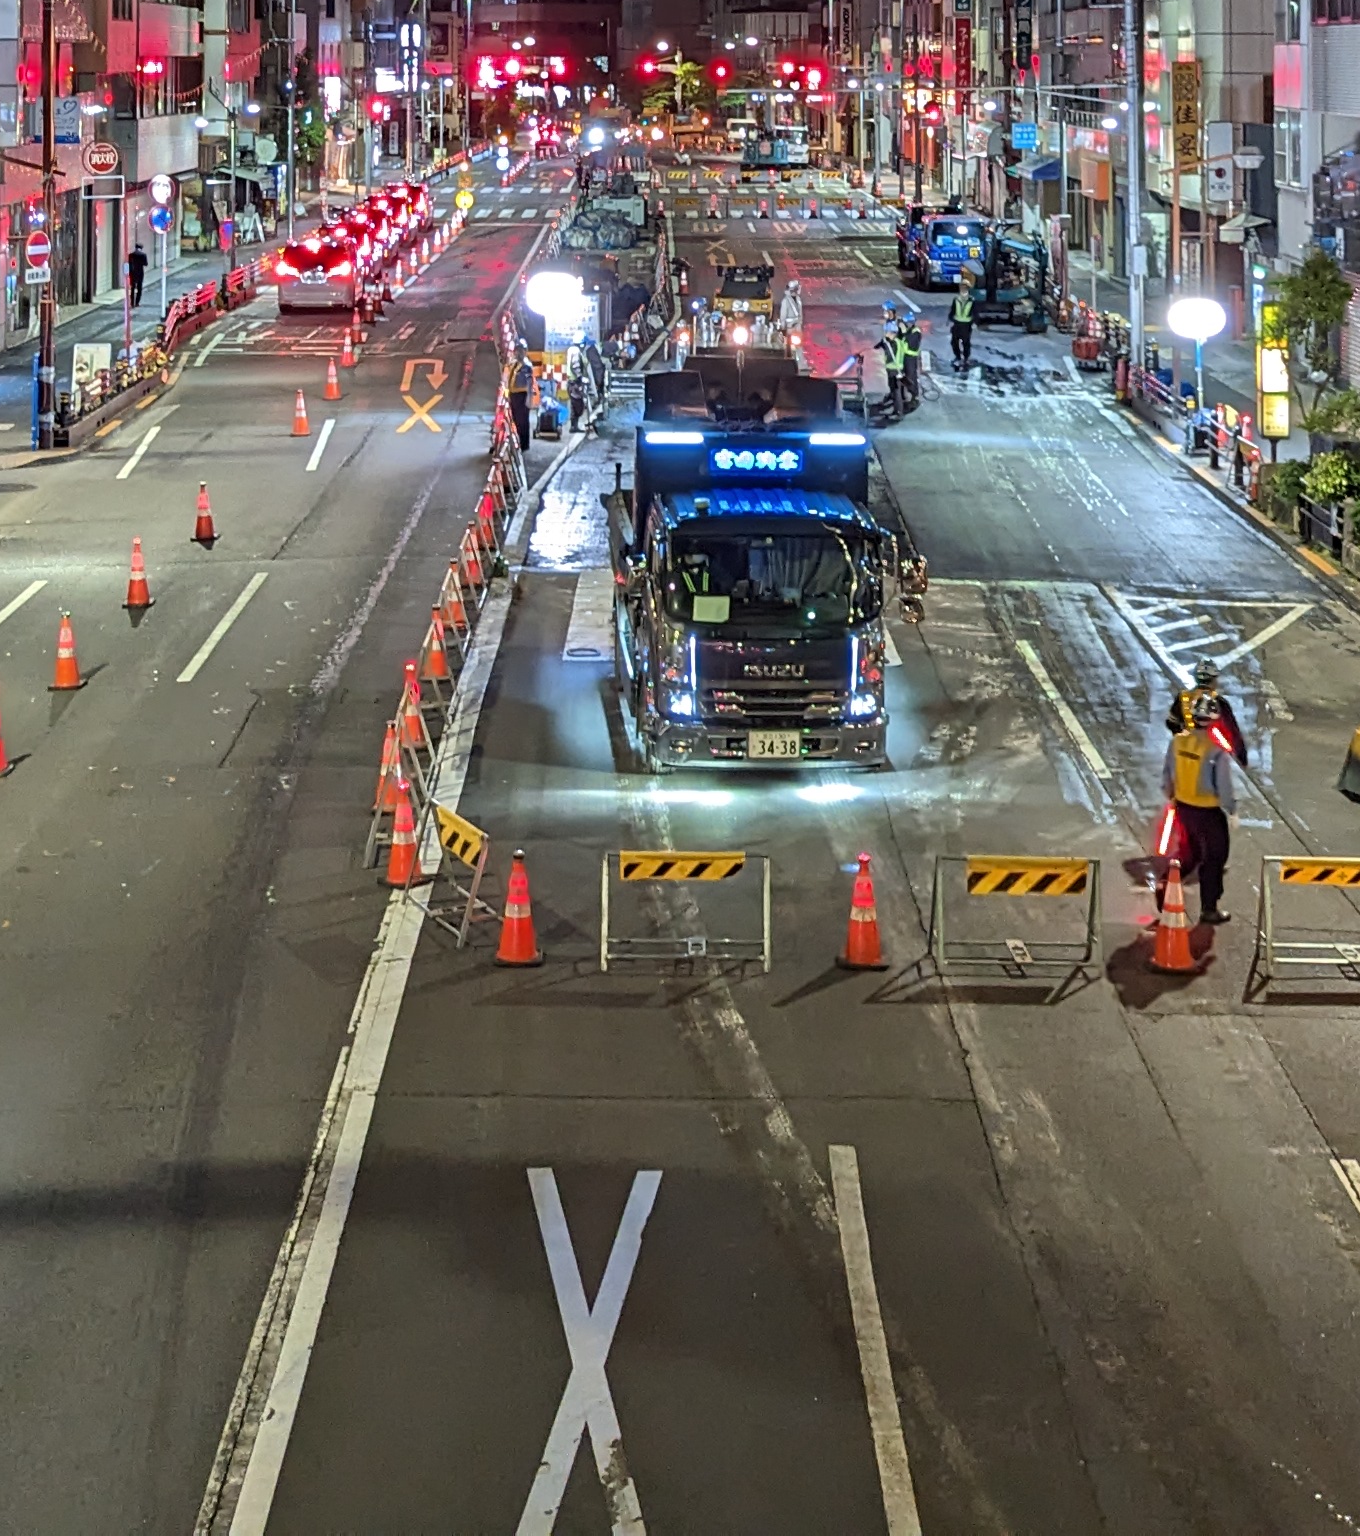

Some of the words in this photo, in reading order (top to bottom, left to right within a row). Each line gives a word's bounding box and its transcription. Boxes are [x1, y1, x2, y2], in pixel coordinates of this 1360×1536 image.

[90, 151, 115, 166] 消火栓
[744, 664, 805, 678] ISUZU
[758, 739, 797, 756] 34-38
